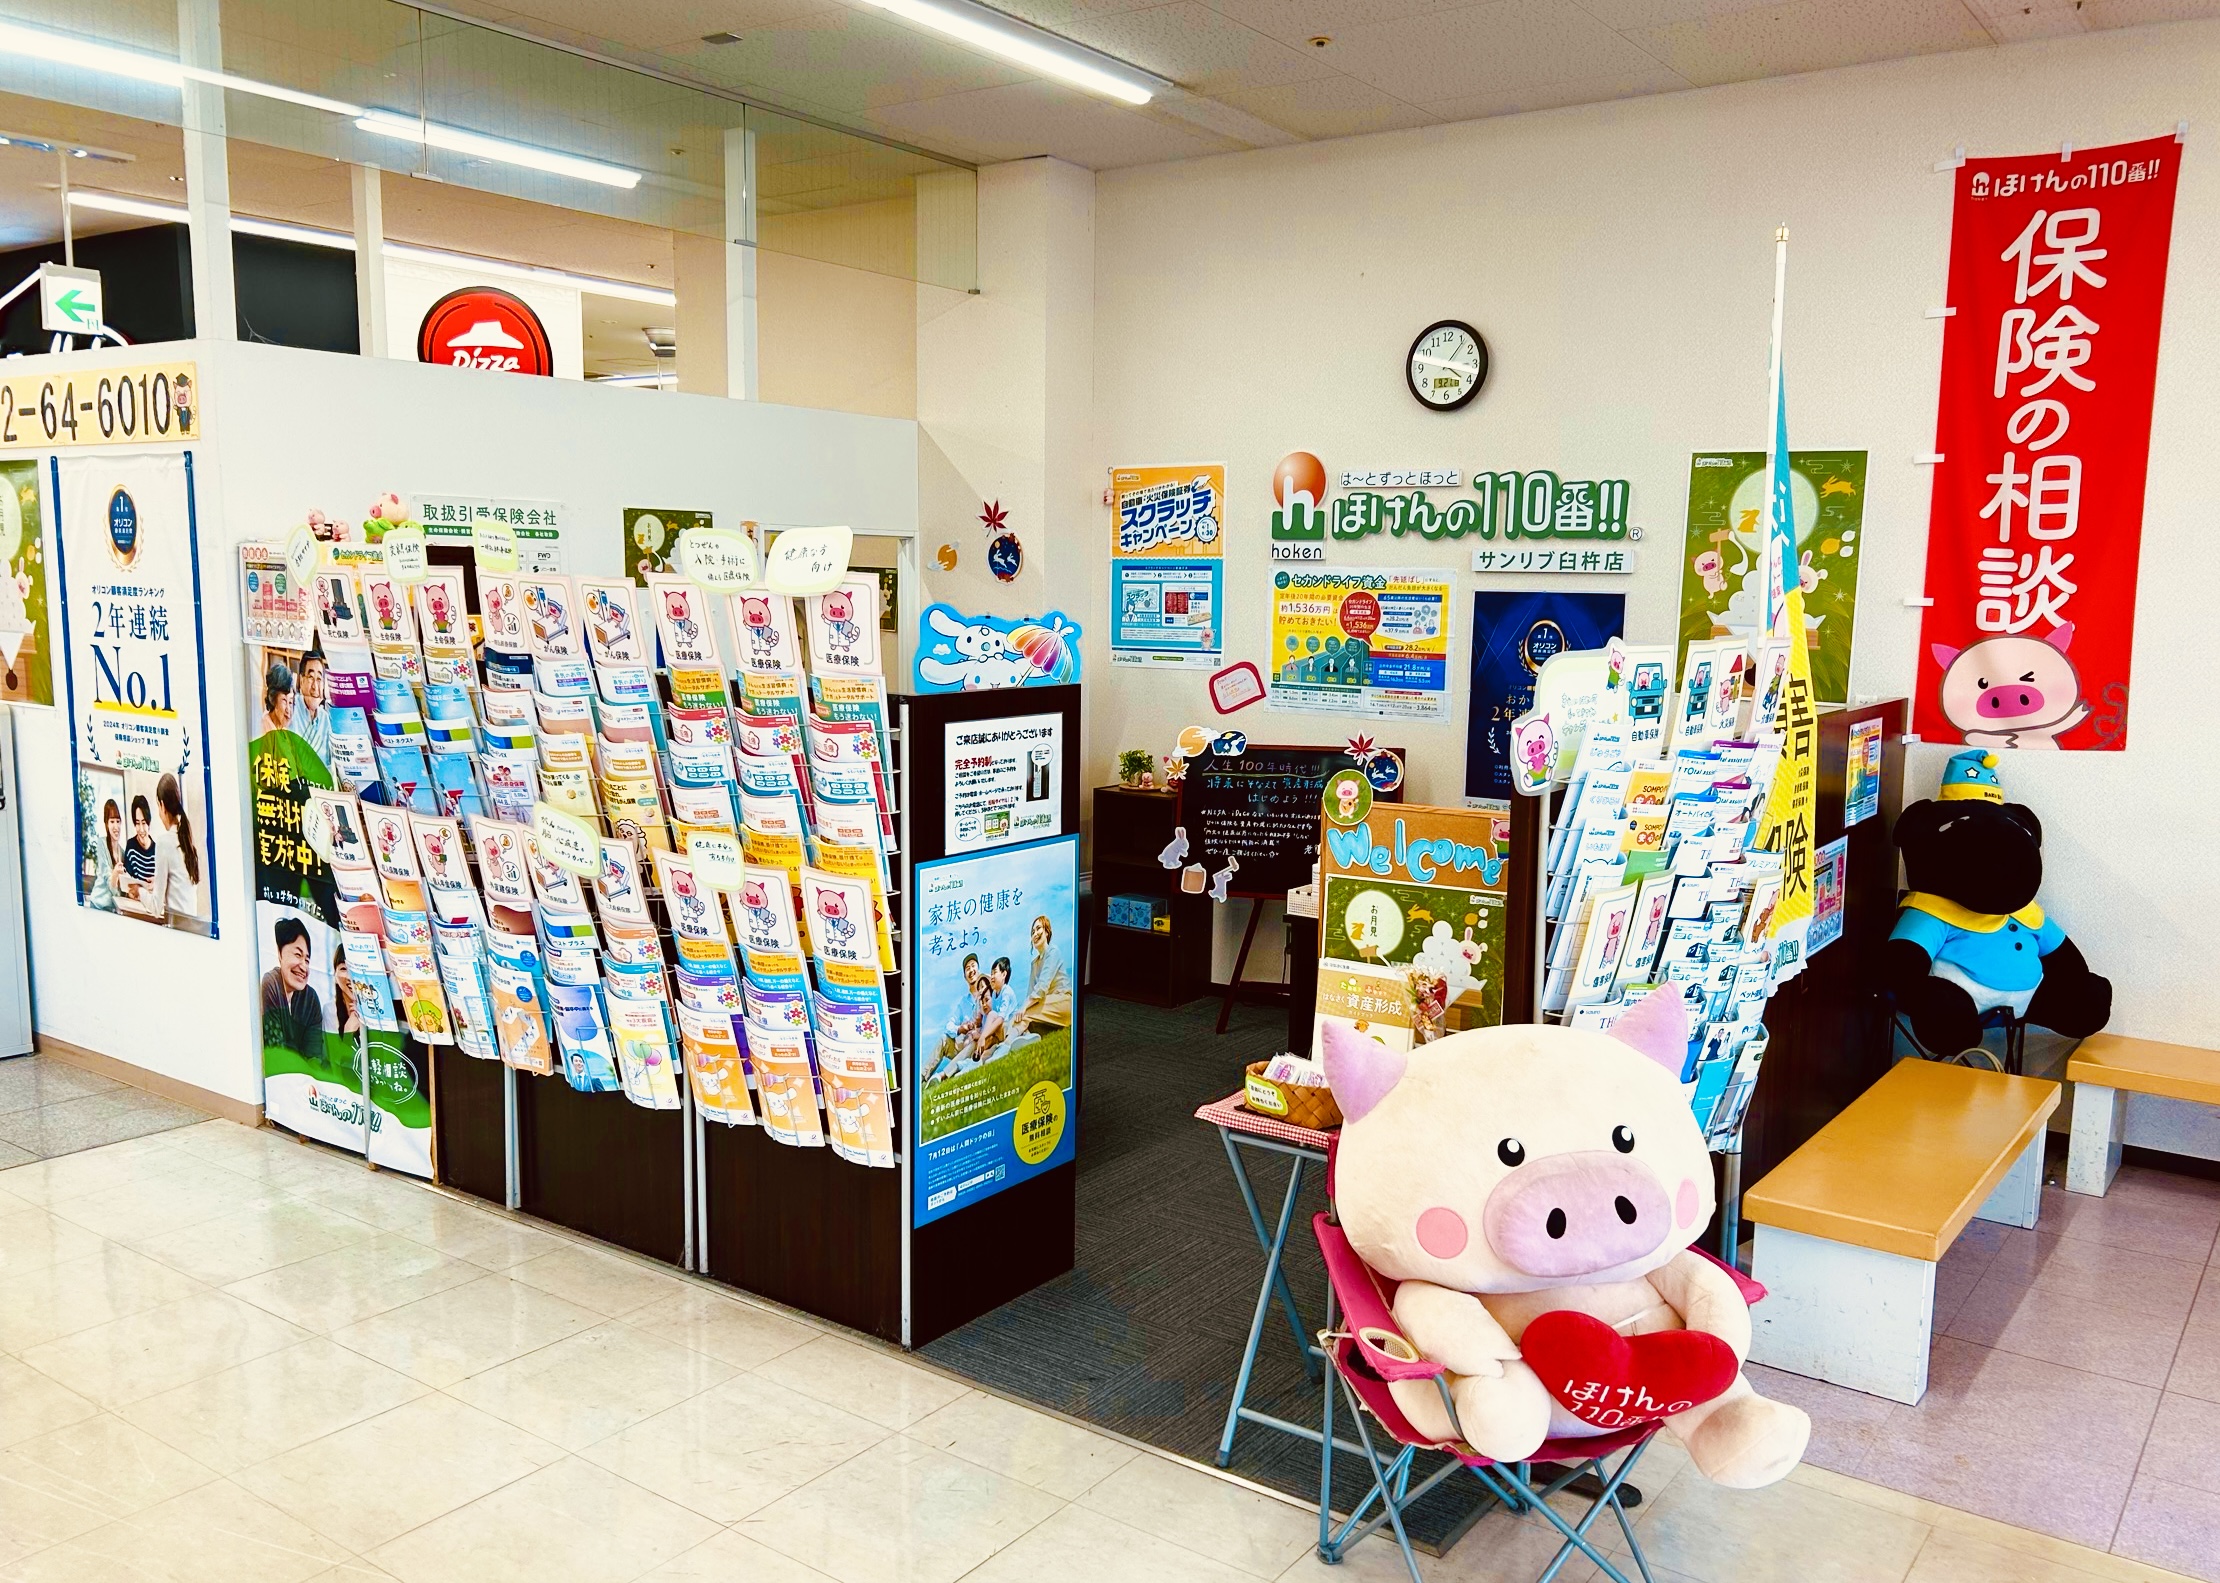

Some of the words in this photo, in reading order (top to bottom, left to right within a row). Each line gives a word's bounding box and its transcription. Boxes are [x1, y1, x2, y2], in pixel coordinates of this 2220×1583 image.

[1431, 337, 1440, 348] 11
[1442, 331, 1454, 343] 12
[1421, 348, 1432, 358] 10
[1467, 344, 1474, 355] 2
[1418, 364, 1424, 374] 9
[1472, 359, 1478, 369] 3
[1421, 378, 1428, 388] 8
[1466, 374, 1473, 385] 4
[1443, 390, 1450, 401] 6
[1974, 208, 2108, 635] 保険の相談
[422, 503, 558, 526] 取扱引受保険会社
[1121, 488, 1212, 532] スクラッチ
[113, 518, 134, 527] オリコン
[1121, 518, 1193, 547] キャンペーン
[537, 552, 552, 560] FWD
[1271, 543, 1322, 560] hoken
[811, 561, 833, 573] 向け
[1479, 550, 1624, 571] サンリブ臼杵店
[1292, 573, 1388, 590] セカンドライフ資金
[91, 585, 165, 598] オリコン顧客満足度ランキング
[91, 601, 170, 642] 2年連続
[327, 629, 350, 639] 死亡保険
[379, 632, 403, 643] 生命保険
[433, 634, 457, 646] 生命保険
[543, 645, 569, 656] がん保険
[604, 650, 631, 661] がん保険
[675, 649, 703, 661] 医療保険
[750, 657, 782, 670] 医療保険
[826, 653, 861, 668] 医療保険
[90, 643, 176, 713] No.1
[1506, 694, 1530, 705] おか
[955, 727, 1054, 746] ご来店誠にありがとうございます
[1631, 727, 1660, 742] 自動車保険
[954, 755, 993, 771] 完全予約制
[253, 752, 292, 794] 保険
[257, 828, 323, 876] 実施中!
[1326, 818, 1503, 887] Welcome
[928, 887, 1024, 926] 家族の健康を
[1369, 904, 1379, 938] お月見
[680, 922, 710, 937] 医療保険
[748, 935, 780, 949] 医療保険
[928, 926, 988, 956] 考えよう。
[823, 945, 858, 961] 医療保険
[1346, 992, 1403, 1016] 資産形成
[1021, 1113, 1059, 1136] 医療保険の
[1028, 1126, 1052, 1143] 無料相談
[1563, 1379, 1693, 1412] ほけんの
